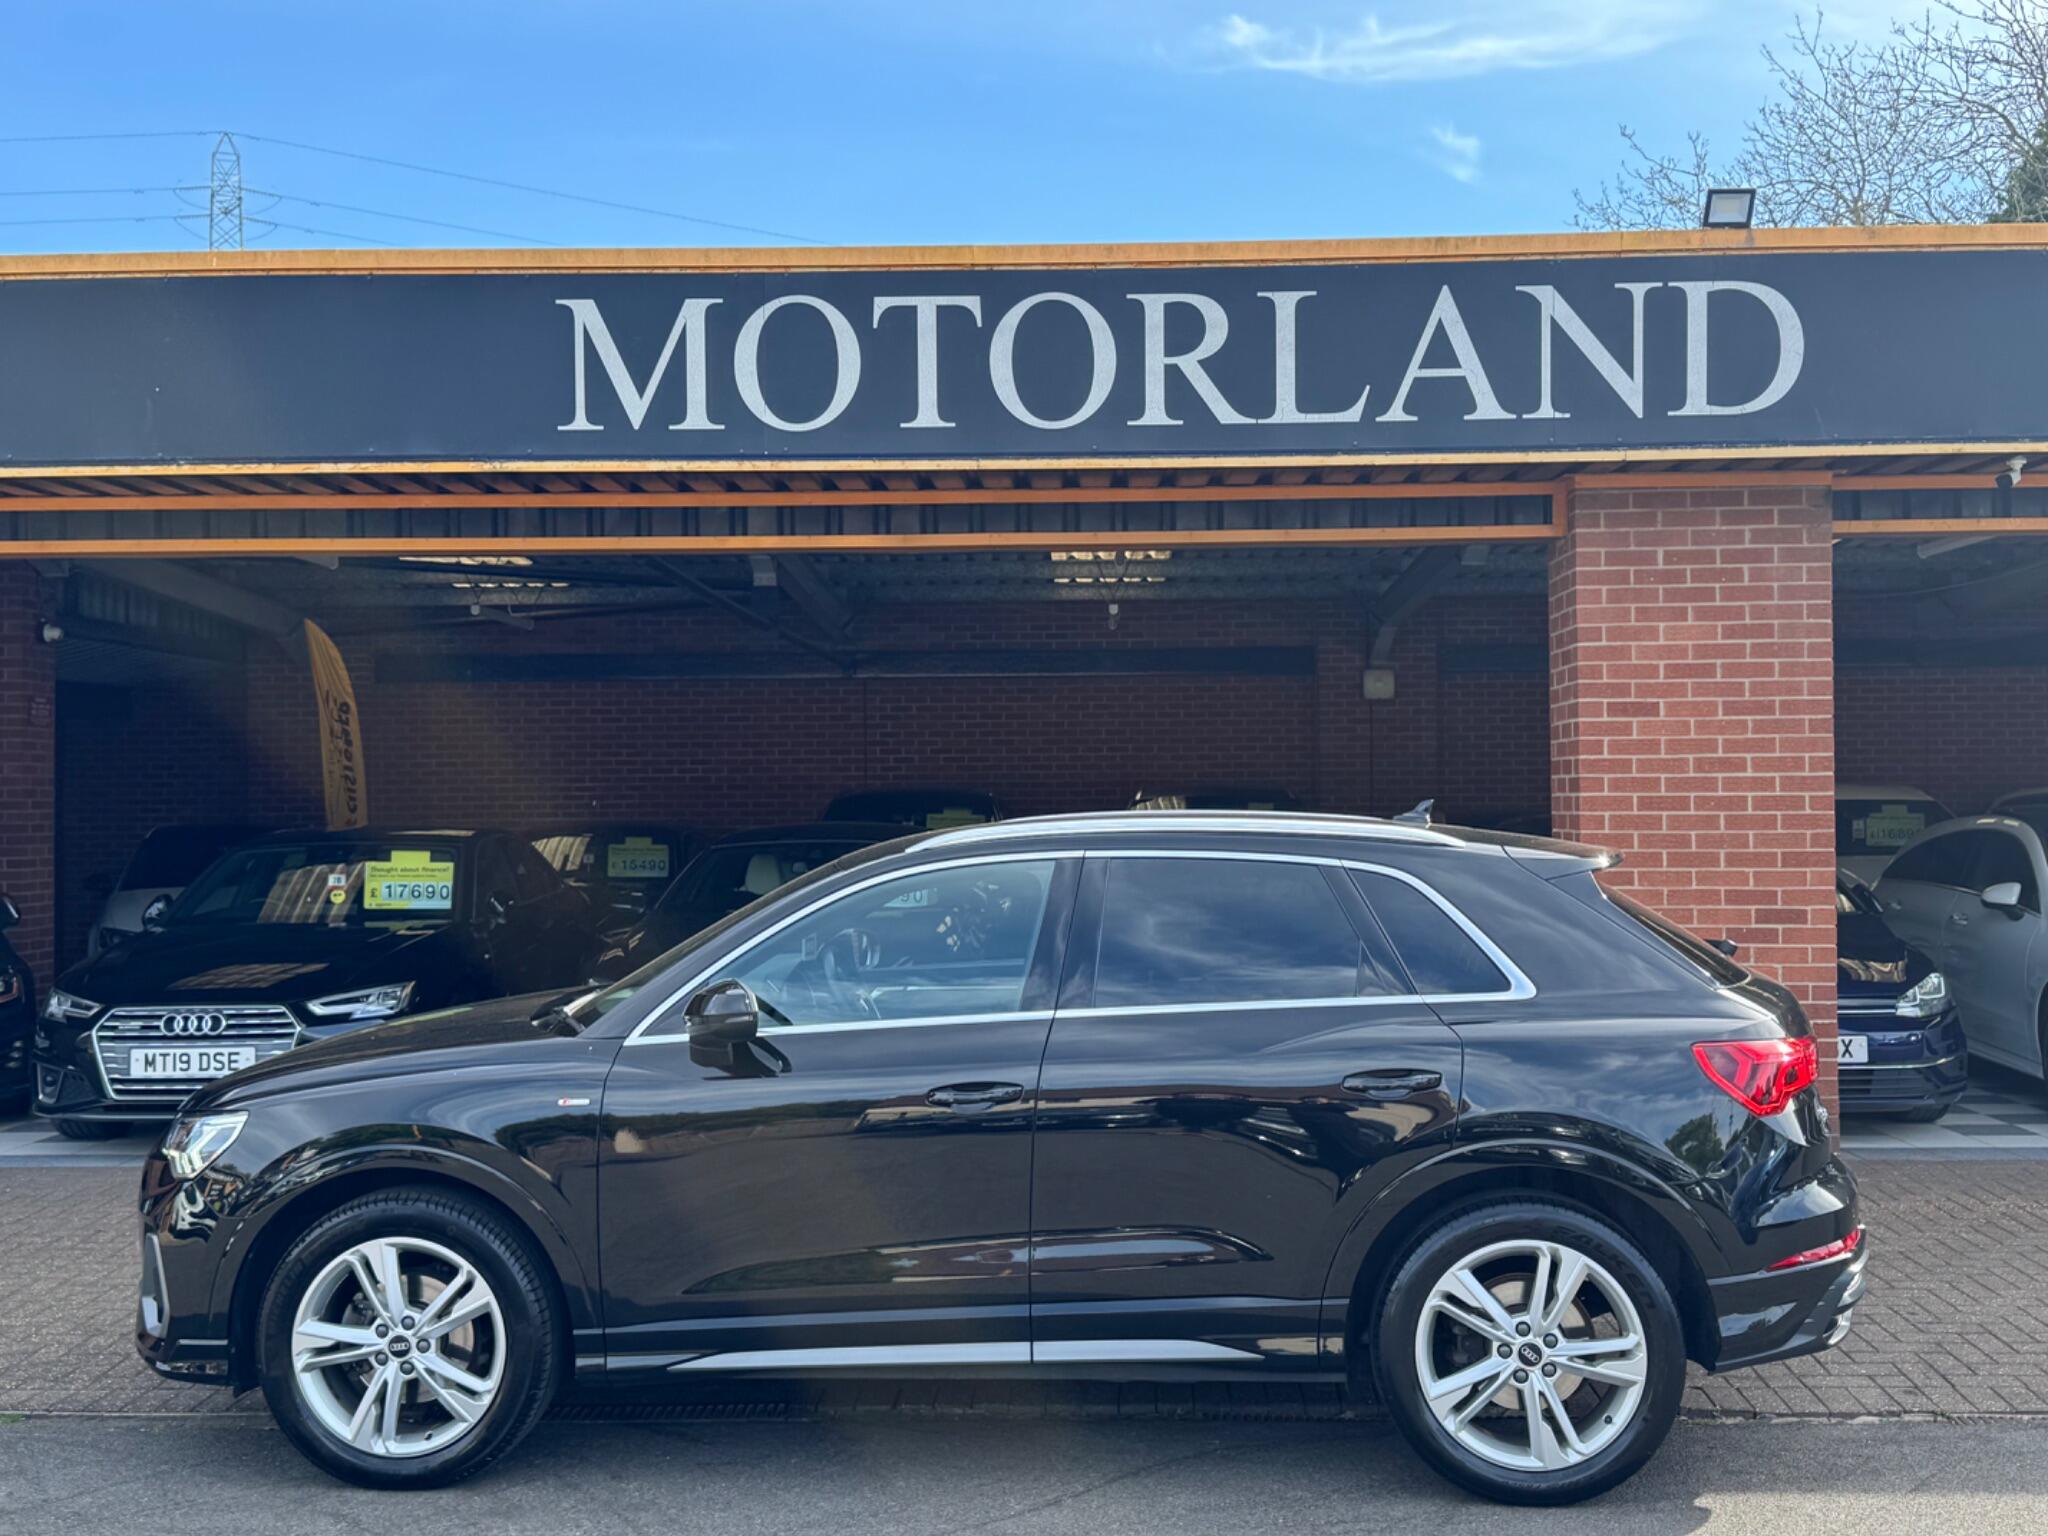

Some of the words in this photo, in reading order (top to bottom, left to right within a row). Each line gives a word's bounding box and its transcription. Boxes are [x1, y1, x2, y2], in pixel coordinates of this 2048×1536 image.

[554, 279, 1806, 433] MOTORLAND
[369, 887, 378, 898] £
[384, 883, 450, 900] 17690
[144, 1052, 191, 1072] MT19
[197, 1051, 241, 1072] DSE
